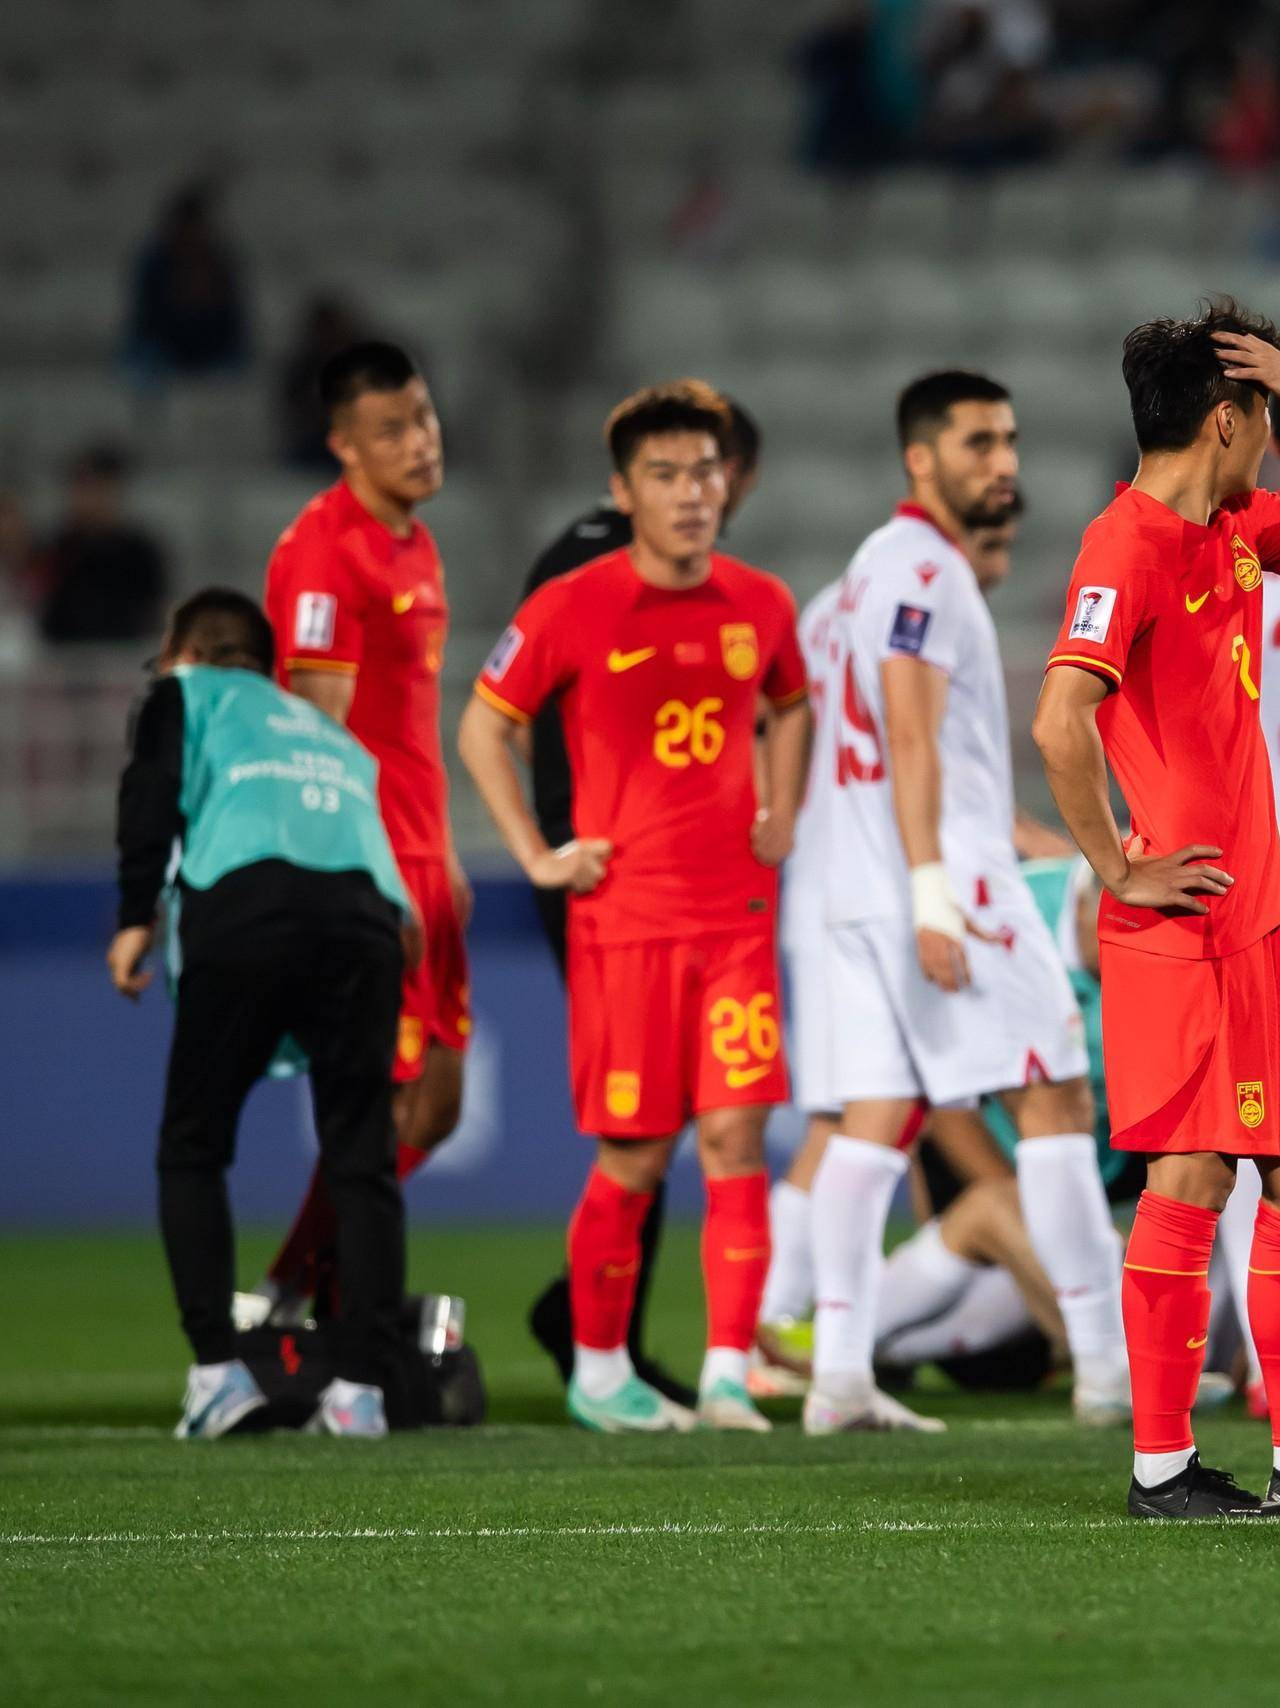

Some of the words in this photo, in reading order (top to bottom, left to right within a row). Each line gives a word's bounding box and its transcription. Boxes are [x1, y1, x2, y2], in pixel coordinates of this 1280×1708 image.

[653, 696, 725, 769] 26
[301, 783, 340, 814] 03
[708, 992, 781, 1065] 26
